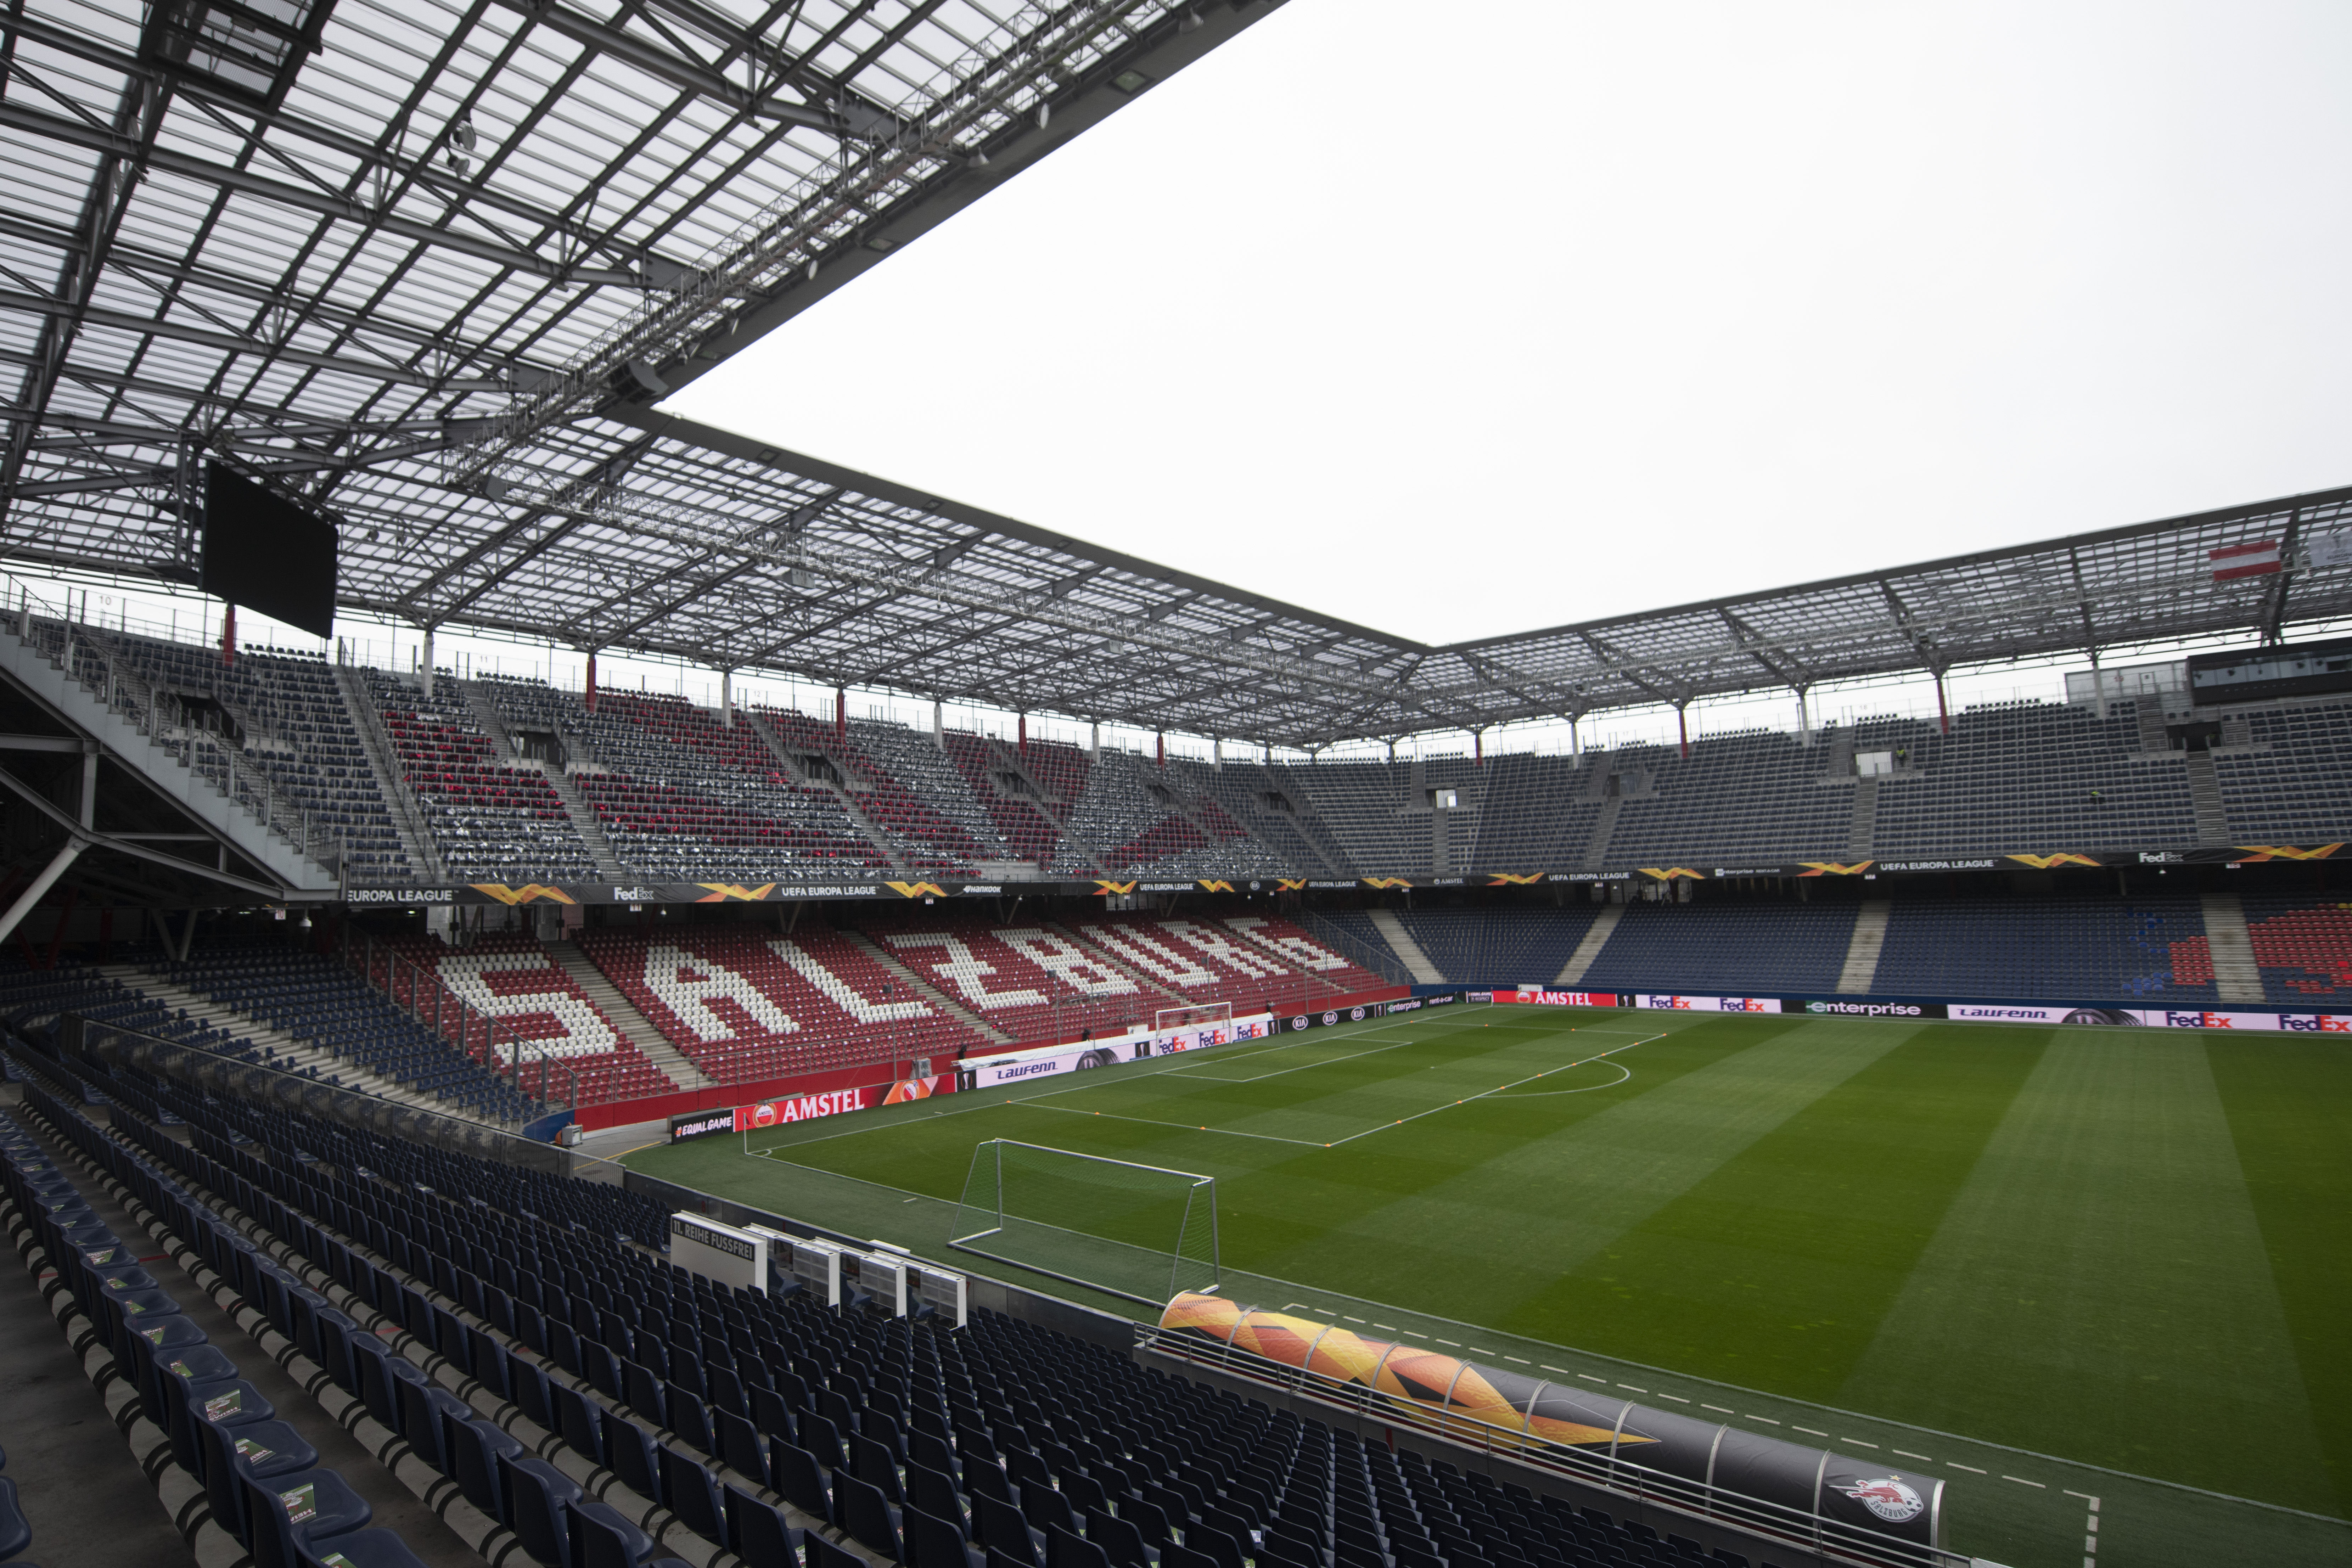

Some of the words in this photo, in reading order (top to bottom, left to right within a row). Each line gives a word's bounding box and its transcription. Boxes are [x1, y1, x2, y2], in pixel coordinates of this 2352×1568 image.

[99, 595, 111, 605] 10
[1951, 860, 1994, 868] LEAGUE
[2139, 852, 2184, 862] FedEx
[398, 890, 452, 901] LEAGUE
[614, 887, 654, 900] FedEx
[782, 887, 807, 896] UEFA
[808, 887, 842, 895] EUROPA
[844, 886, 876, 895] LEAGUE
[277, 909, 284, 919] 10
[437, 917, 1348, 1063] SALZBURG
[1429, 995, 1453, 1005] rent-a-car
[1535, 991, 1593, 1006] AMSTEL
[1649, 995, 1691, 1009] FedEx
[1720, 998, 1765, 1012] FedEx
[1388, 1000, 1420, 1012] enterprise
[1806, 1001, 1921, 1016] enterprise
[2165, 1012, 2233, 1028] FedEx
[2278, 1014, 2351, 1032] FedEx
[1199, 1030, 1226, 1047] FedEx
[1237, 1024, 1262, 1039] FedEx
[1159, 1036, 1186, 1054] FedEx
[783, 1089, 864, 1123] AMSTEL
[673, 1220, 683, 1235] 11.
[685, 1223, 709, 1244] REIHE
[711, 1228, 753, 1259] FUSSFREI
[1870, 1501, 1908, 1517] SALZBURG
